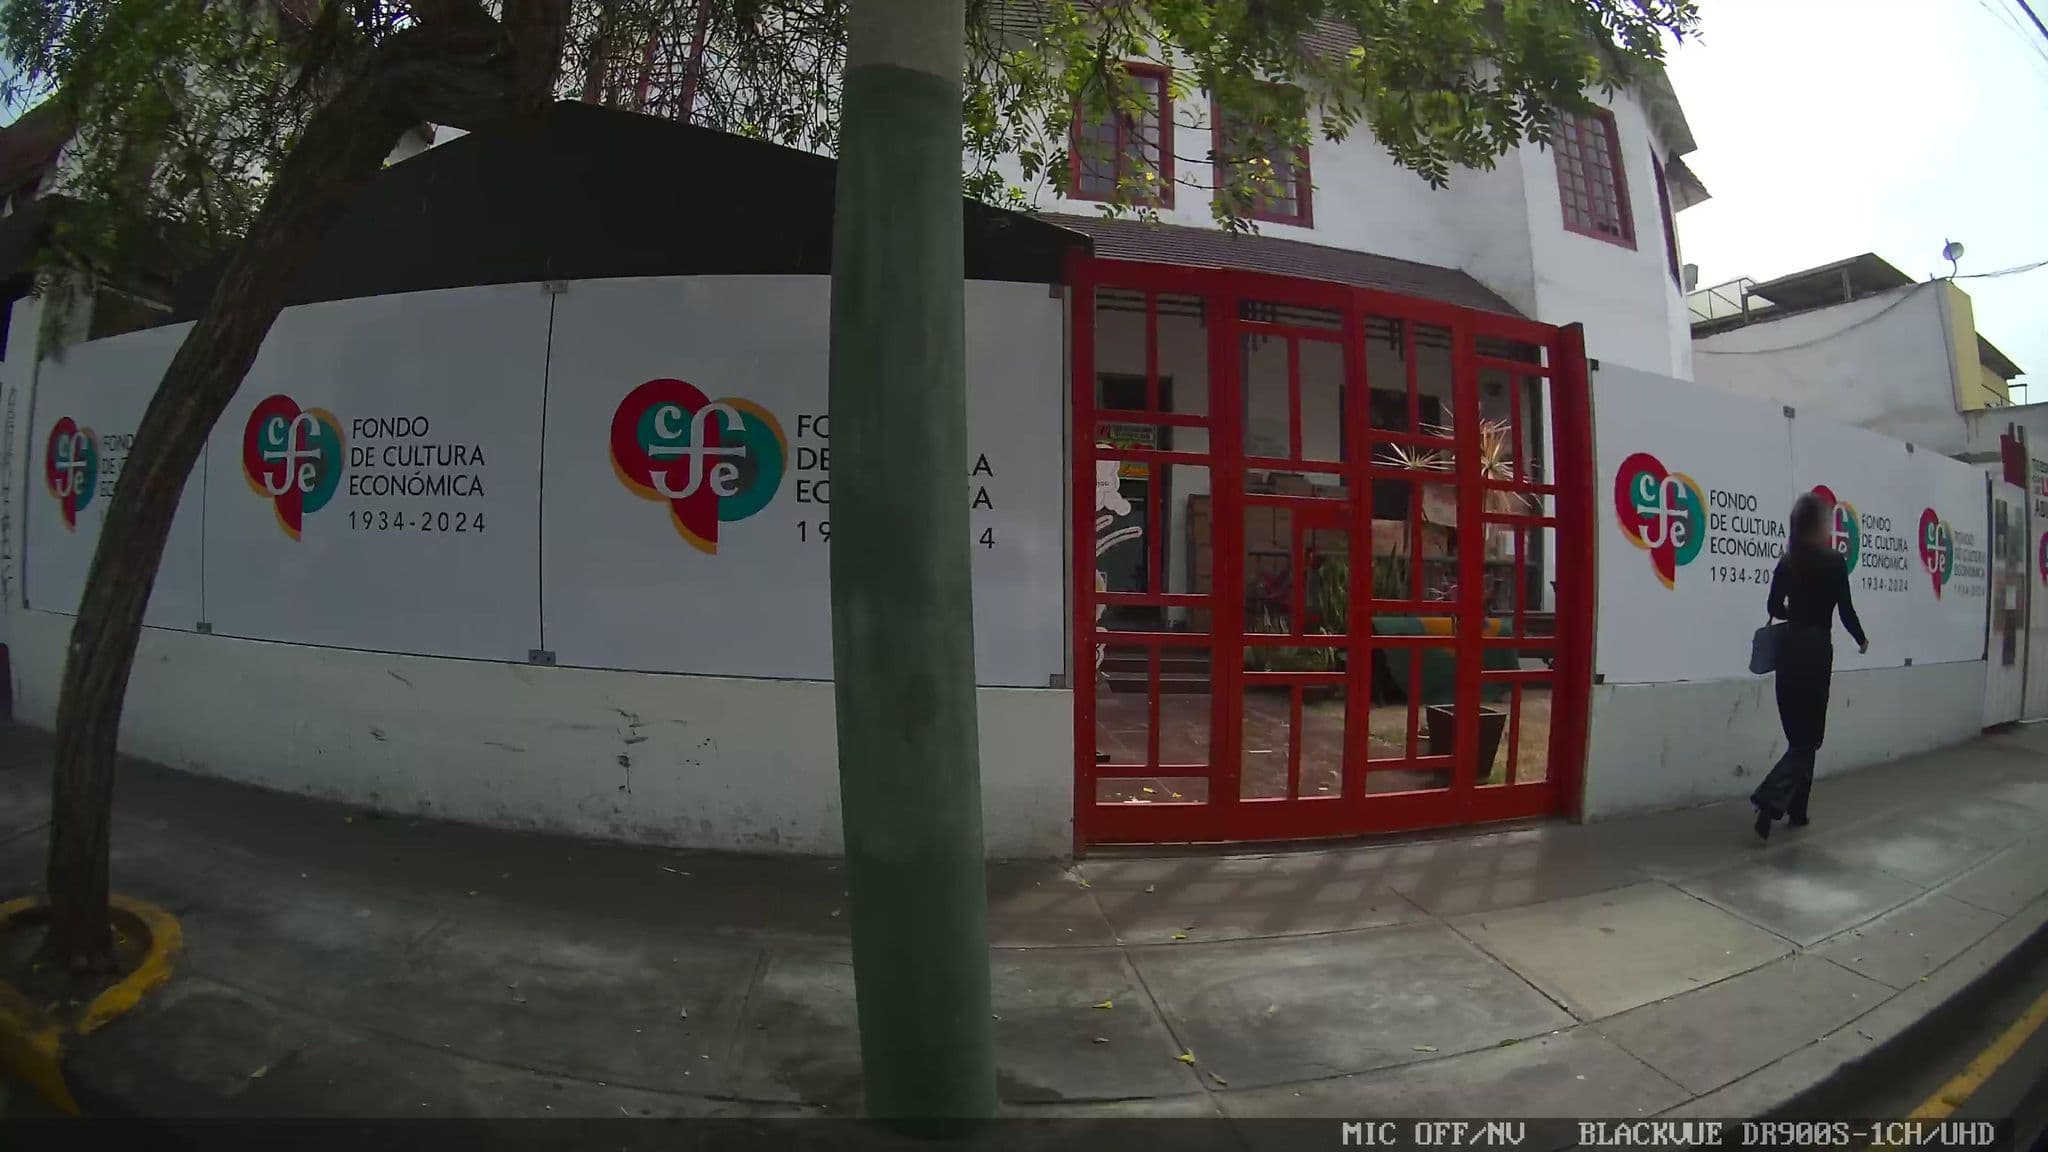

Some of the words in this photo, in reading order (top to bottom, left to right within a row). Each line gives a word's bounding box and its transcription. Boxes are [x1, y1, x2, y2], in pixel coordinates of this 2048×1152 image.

[353, 416, 428, 439] FONDO
[351, 447, 375, 466] DE
[383, 445, 485, 467] CULTURA
[349, 471, 484, 497] ECONÓMICA
[1710, 490, 1757, 512] FONDO
[349, 511, 486, 533] 1934-2024
[1710, 514, 1730, 532] DE
[1732, 516, 1786, 538] CULTURA
[1861, 513, 1891, 533] FONDO
[1861, 534, 1874, 549] DE
[1875, 536, 1908, 553] CULTURA
[1710, 566, 1776, 585] 1934-20
